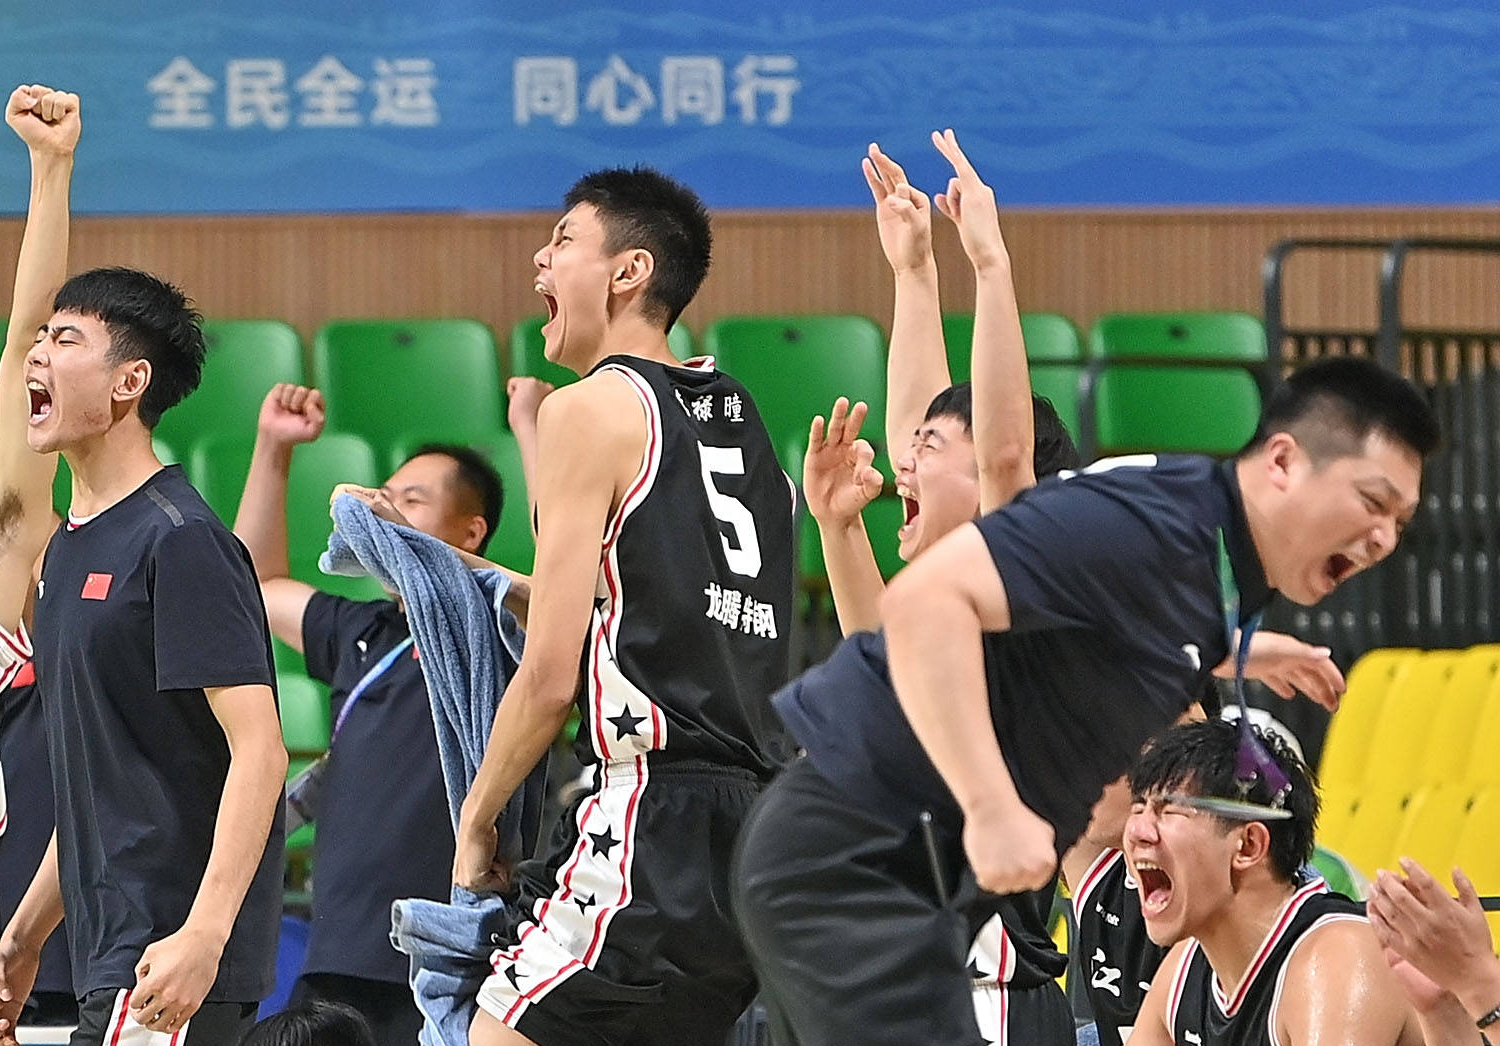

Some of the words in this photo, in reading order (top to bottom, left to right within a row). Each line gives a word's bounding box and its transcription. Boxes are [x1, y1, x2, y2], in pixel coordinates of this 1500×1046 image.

[146, 55, 440, 130] 全民全运
[513, 55, 800, 128] 同心同行
[697, 440, 762, 578] 5
